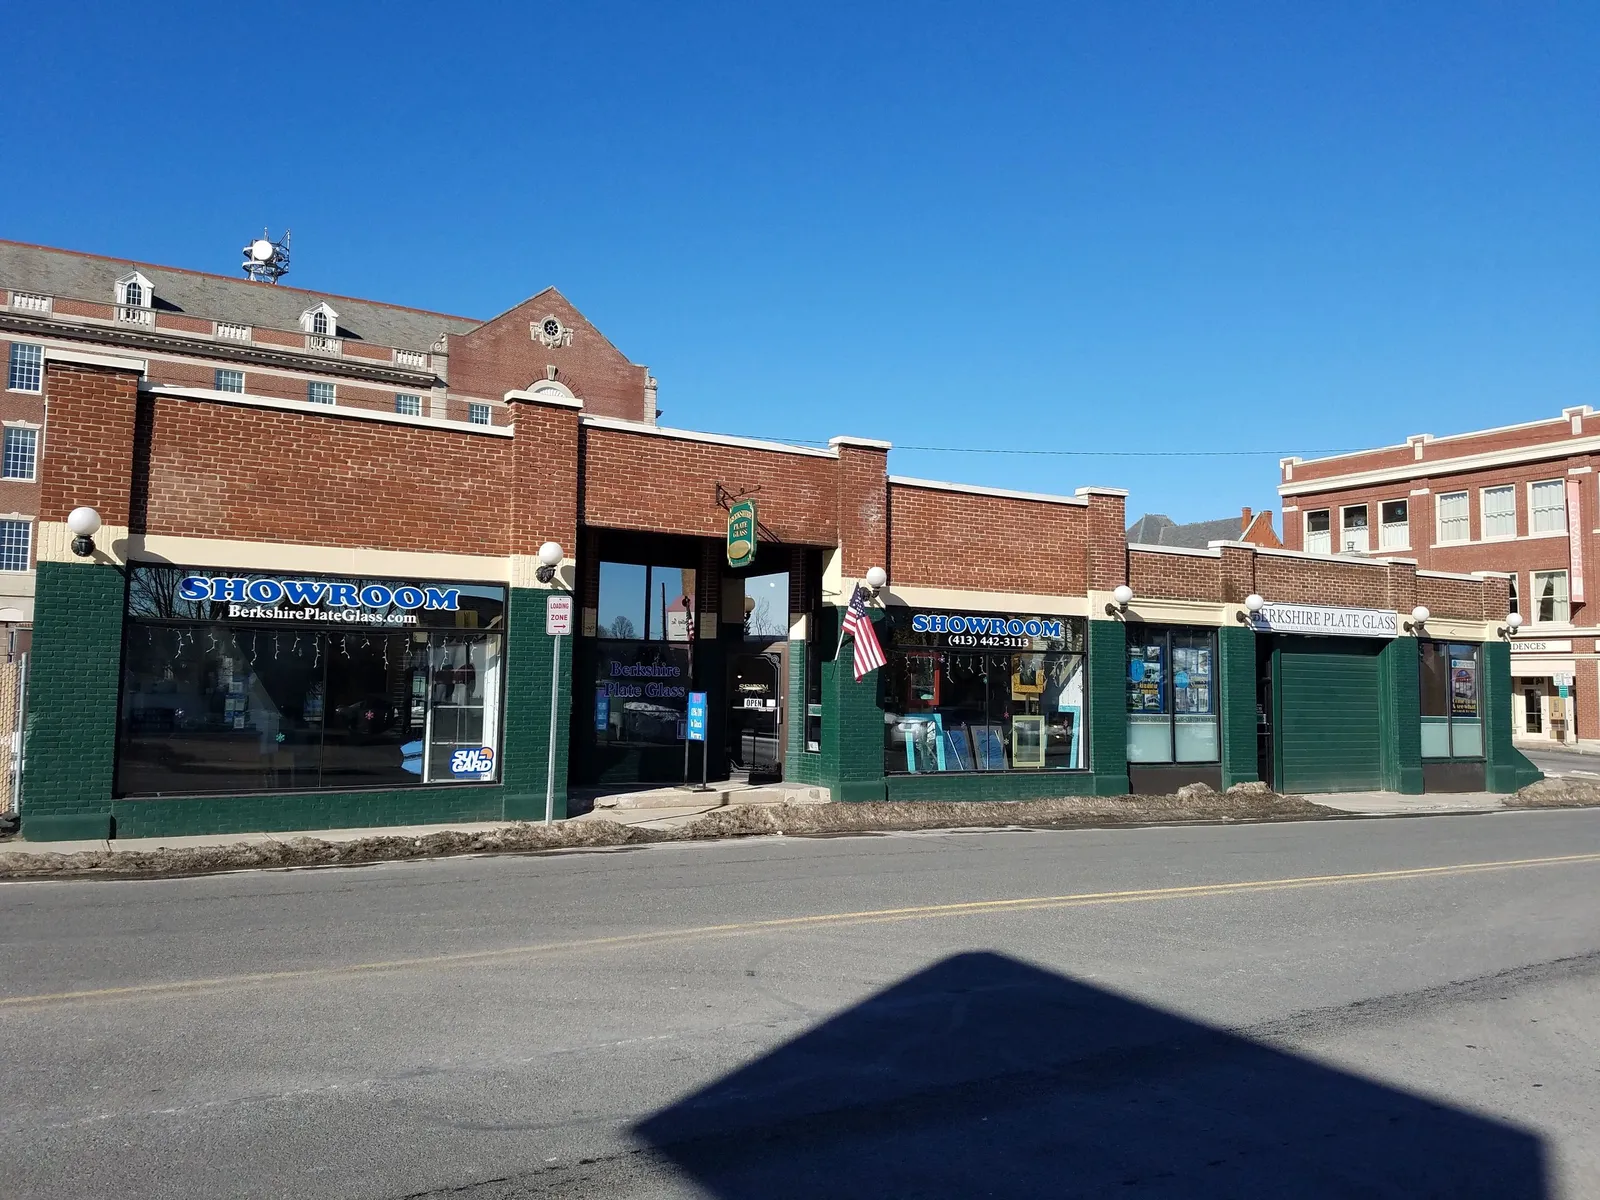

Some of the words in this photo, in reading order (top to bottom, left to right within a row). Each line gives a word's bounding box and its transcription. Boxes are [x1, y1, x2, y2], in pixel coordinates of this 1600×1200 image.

[178, 575, 461, 611] SHOWROOM
[228, 604, 417, 625] BerkshirePlateGlass.com
[550, 602, 569, 610] LOADING
[912, 614, 1062, 638] SHOWROOM
[1323, 611, 1360, 631] PLATE
[1362, 614, 1396, 631] GLASS
[948, 634, 977, 646] (413)
[979, 637, 1029, 648] 442-3113
[610, 660, 681, 677] Berkshire
[603, 681, 642, 698] Plate
[645, 682, 685, 698] Glass
[746, 699, 762, 707] OPEN
[452, 759, 492, 772] GARD
